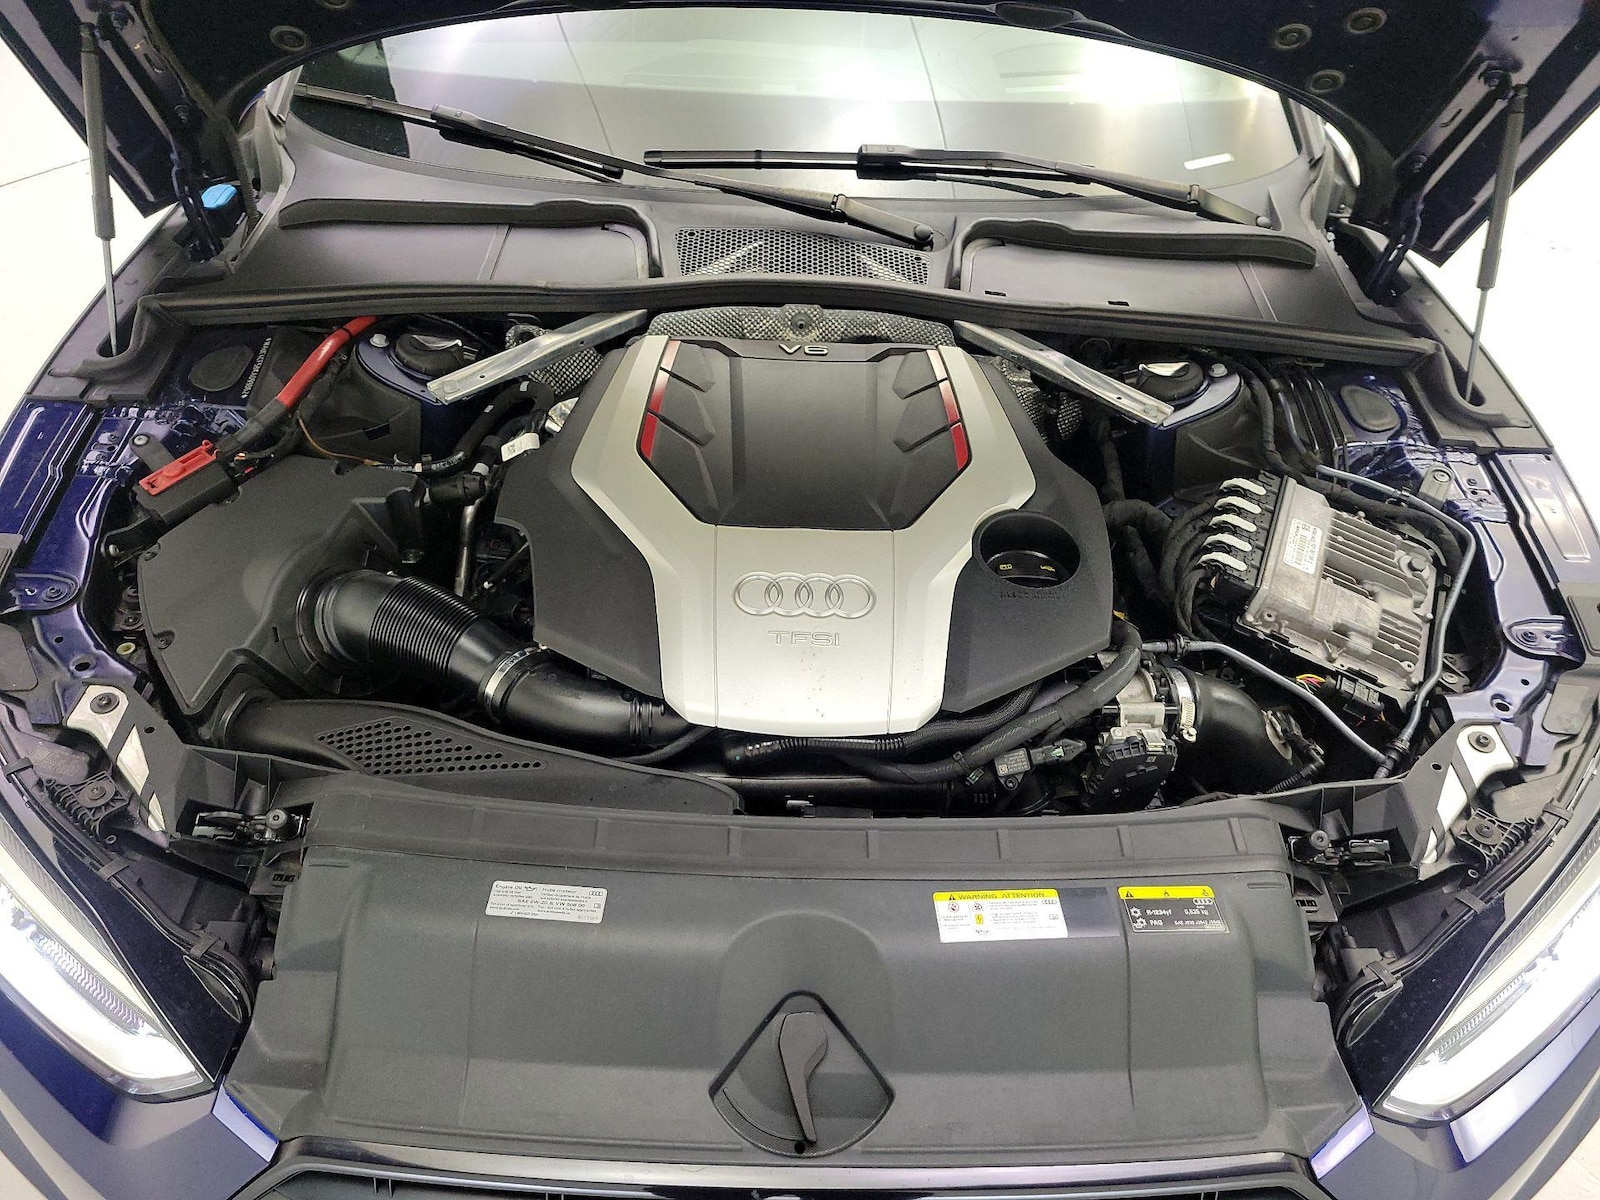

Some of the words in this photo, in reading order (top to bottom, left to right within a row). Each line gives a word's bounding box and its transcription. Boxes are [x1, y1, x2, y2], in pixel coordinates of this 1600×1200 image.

[779, 343, 829, 356] V6
[768, 630, 840, 647] TFSI
[1001, 891, 1046, 899] ATTENTION
